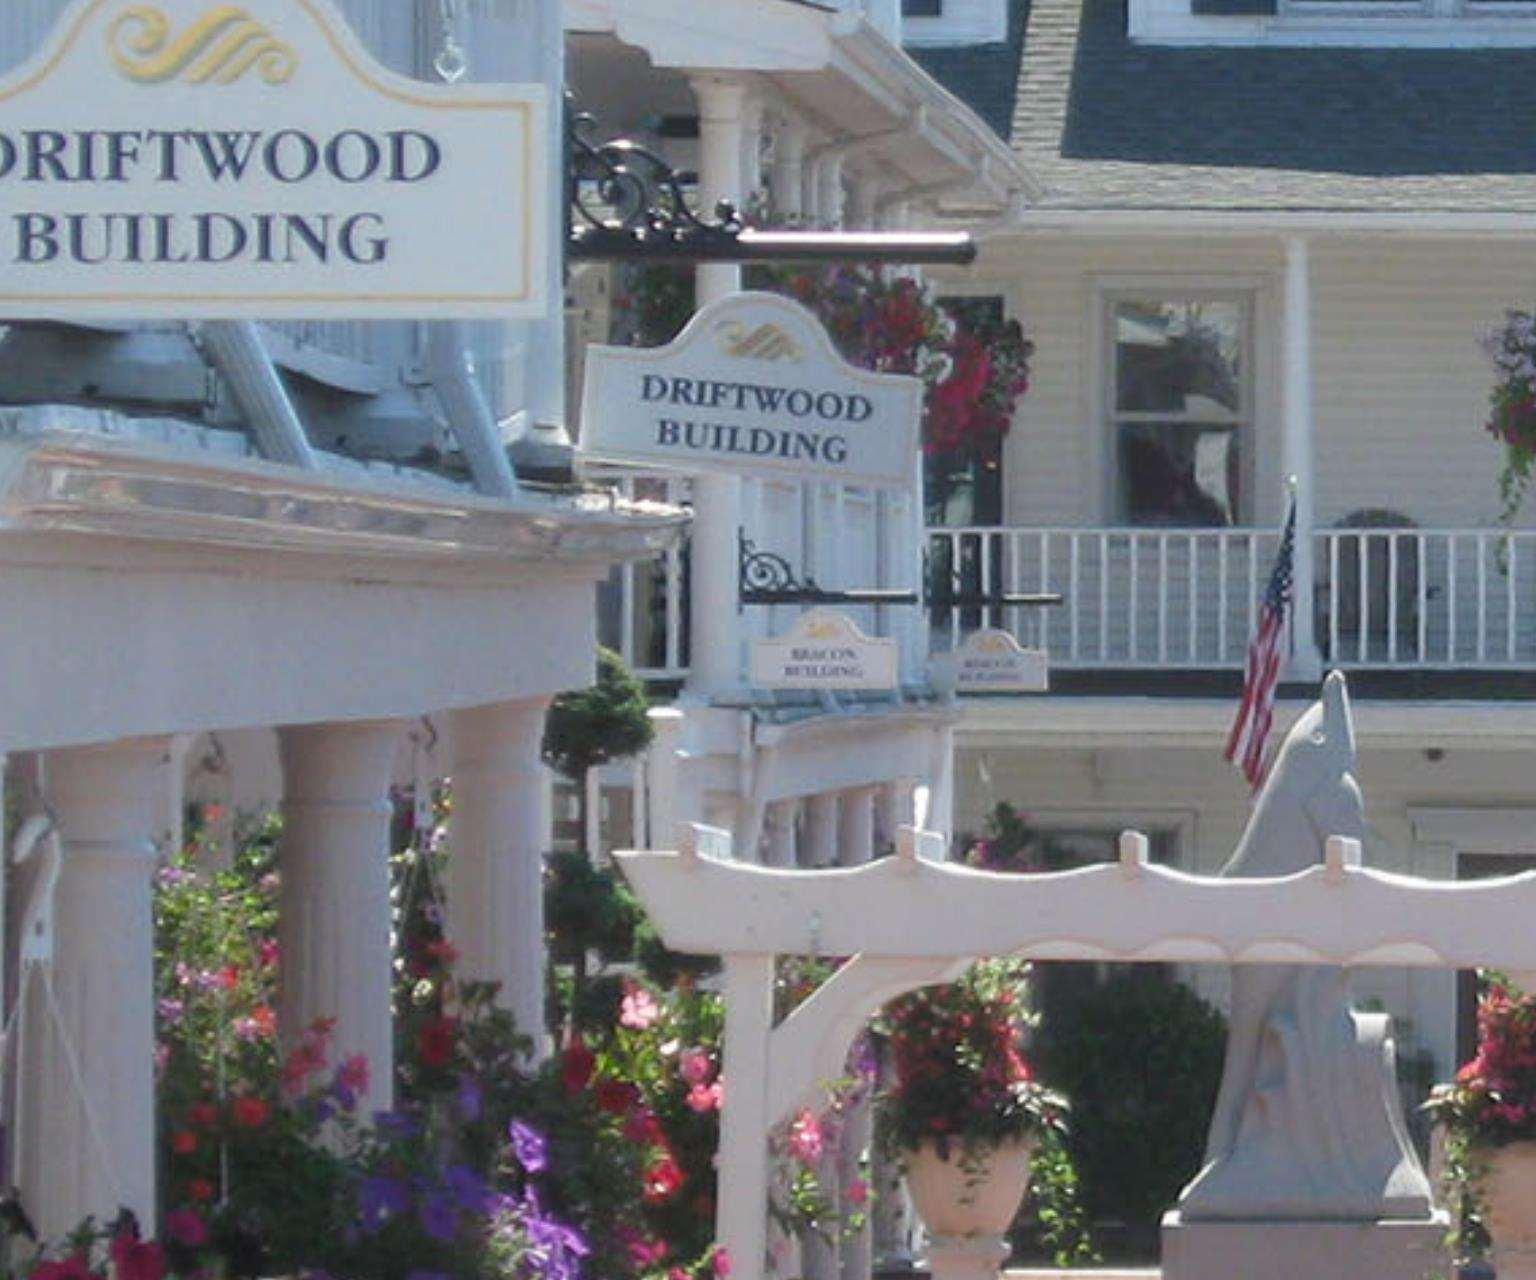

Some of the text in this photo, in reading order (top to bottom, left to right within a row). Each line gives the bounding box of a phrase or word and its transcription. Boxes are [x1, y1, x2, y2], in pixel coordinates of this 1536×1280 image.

[14, 212, 389, 264] BUILDING
[642, 374, 872, 422] DRIFTWOOD
[657, 419, 848, 462] BUILDING
[784, 664, 864, 678] BUILDING
